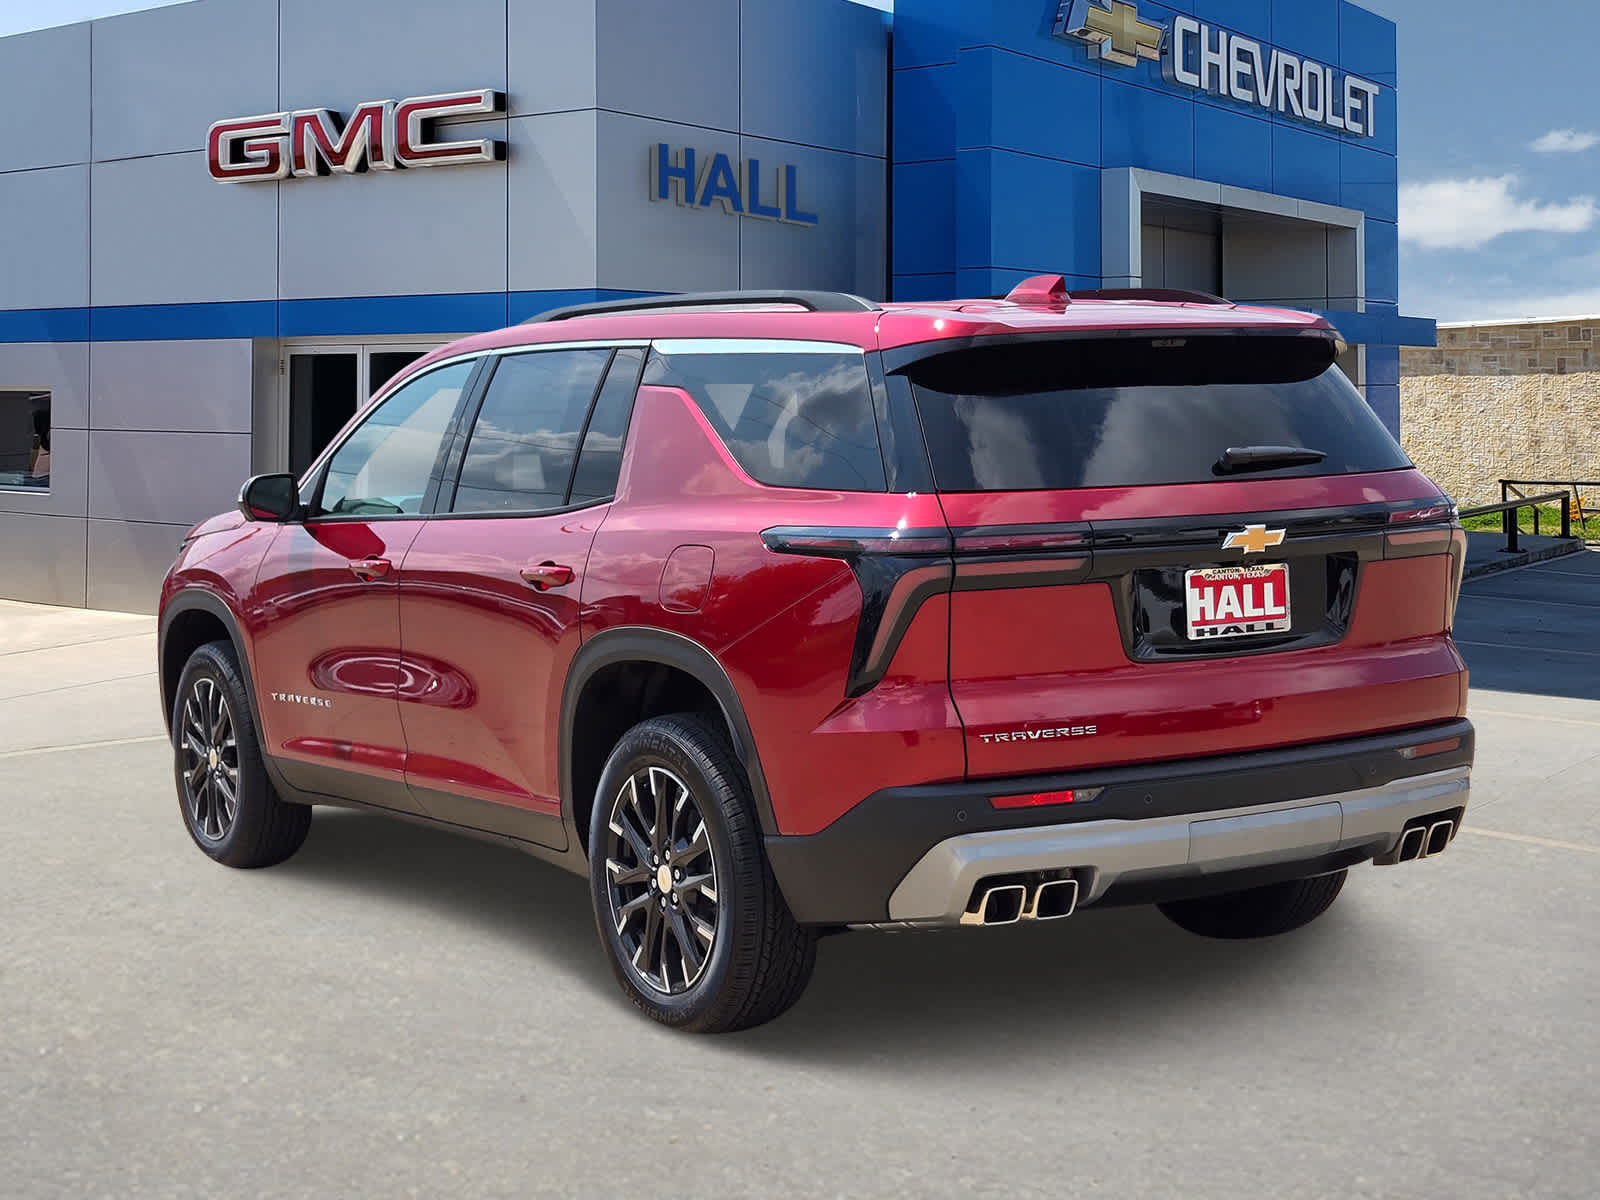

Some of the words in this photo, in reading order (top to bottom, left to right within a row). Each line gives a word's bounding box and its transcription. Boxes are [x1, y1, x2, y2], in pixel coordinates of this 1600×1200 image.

[1174, 15, 1380, 137] CHEVROLET
[207, 88, 504, 184] GMC
[652, 142, 818, 226] HALL
[1190, 583, 1285, 621] HALL
[1196, 622, 1286, 637] HALL
[271, 692, 332, 707] TRAVERSE
[979, 725, 1097, 743] TRAVERSE
